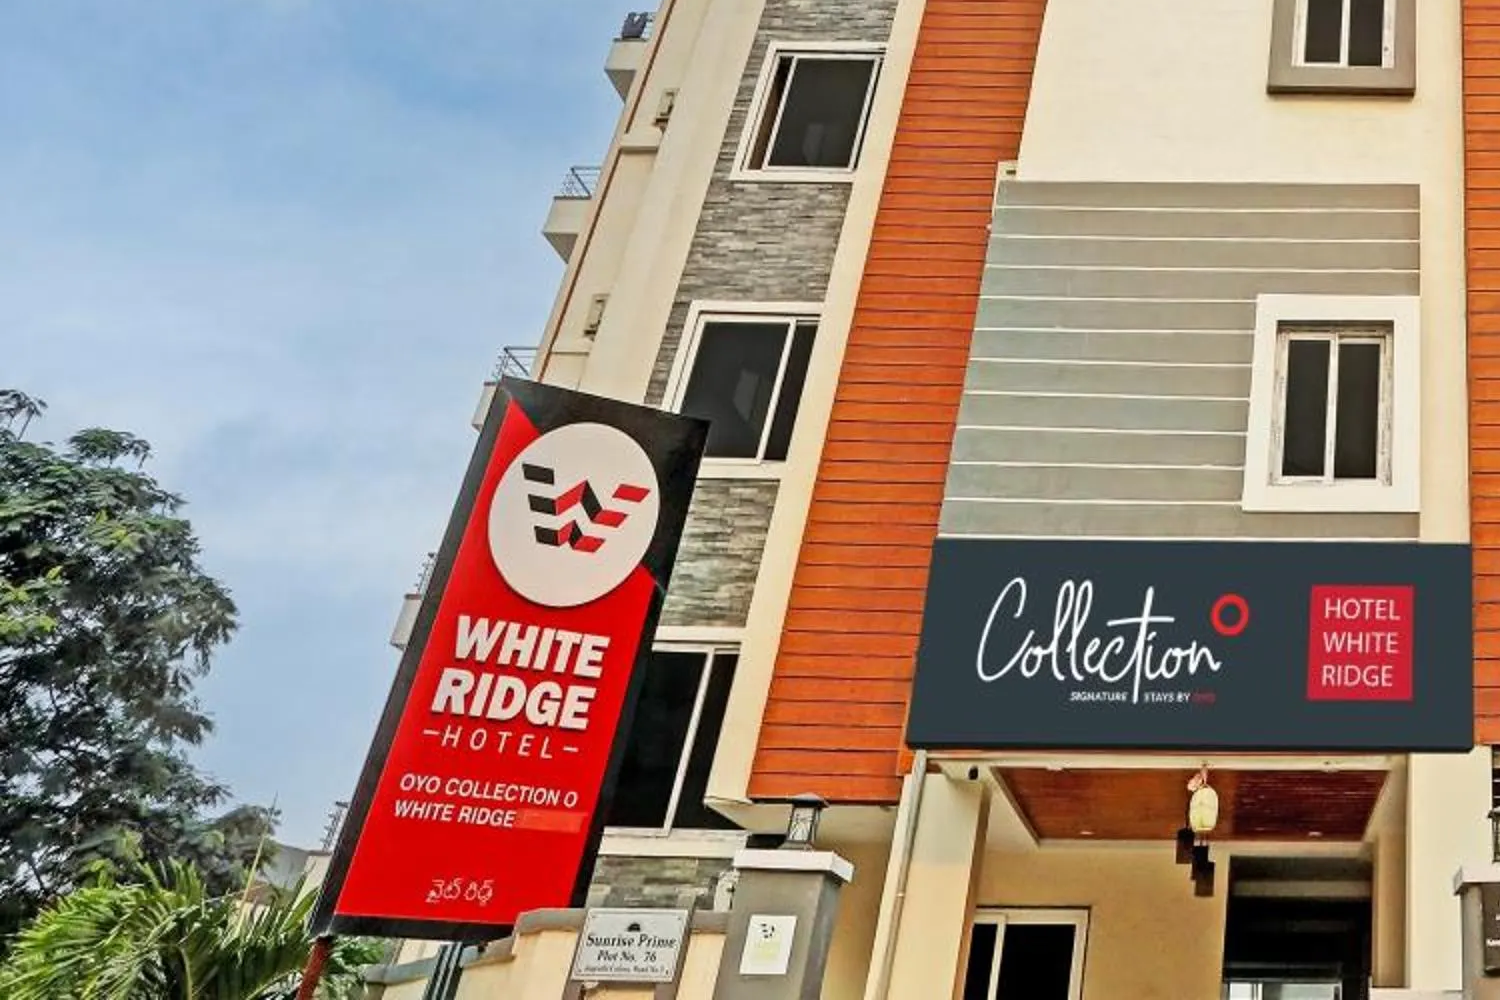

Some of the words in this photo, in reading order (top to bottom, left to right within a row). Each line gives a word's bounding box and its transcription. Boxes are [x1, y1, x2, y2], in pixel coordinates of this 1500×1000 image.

[1324, 598, 1401, 620] HOTEL
[455, 614, 610, 679] WHITE
[976, 577, 1222, 704] Collection
[1323, 631, 1399, 654] WHITE
[1322, 664, 1393, 687] RIDGE
[431, 667, 597, 729] RIDGE
[1070, 691, 1129, 702] SIGNATURE
[1143, 691, 1175, 702] STAYS
[1176, 692, 1191, 703] BY
[400, 773, 441, 793] OYO
[445, 778, 560, 807] COLLECTION
[563, 791, 578, 808] O
[394, 800, 455, 821] WHITE
[457, 806, 517, 828] RIDGE
[586, 934, 635, 947] Sunrise
[638, 933, 677, 948] Prime
